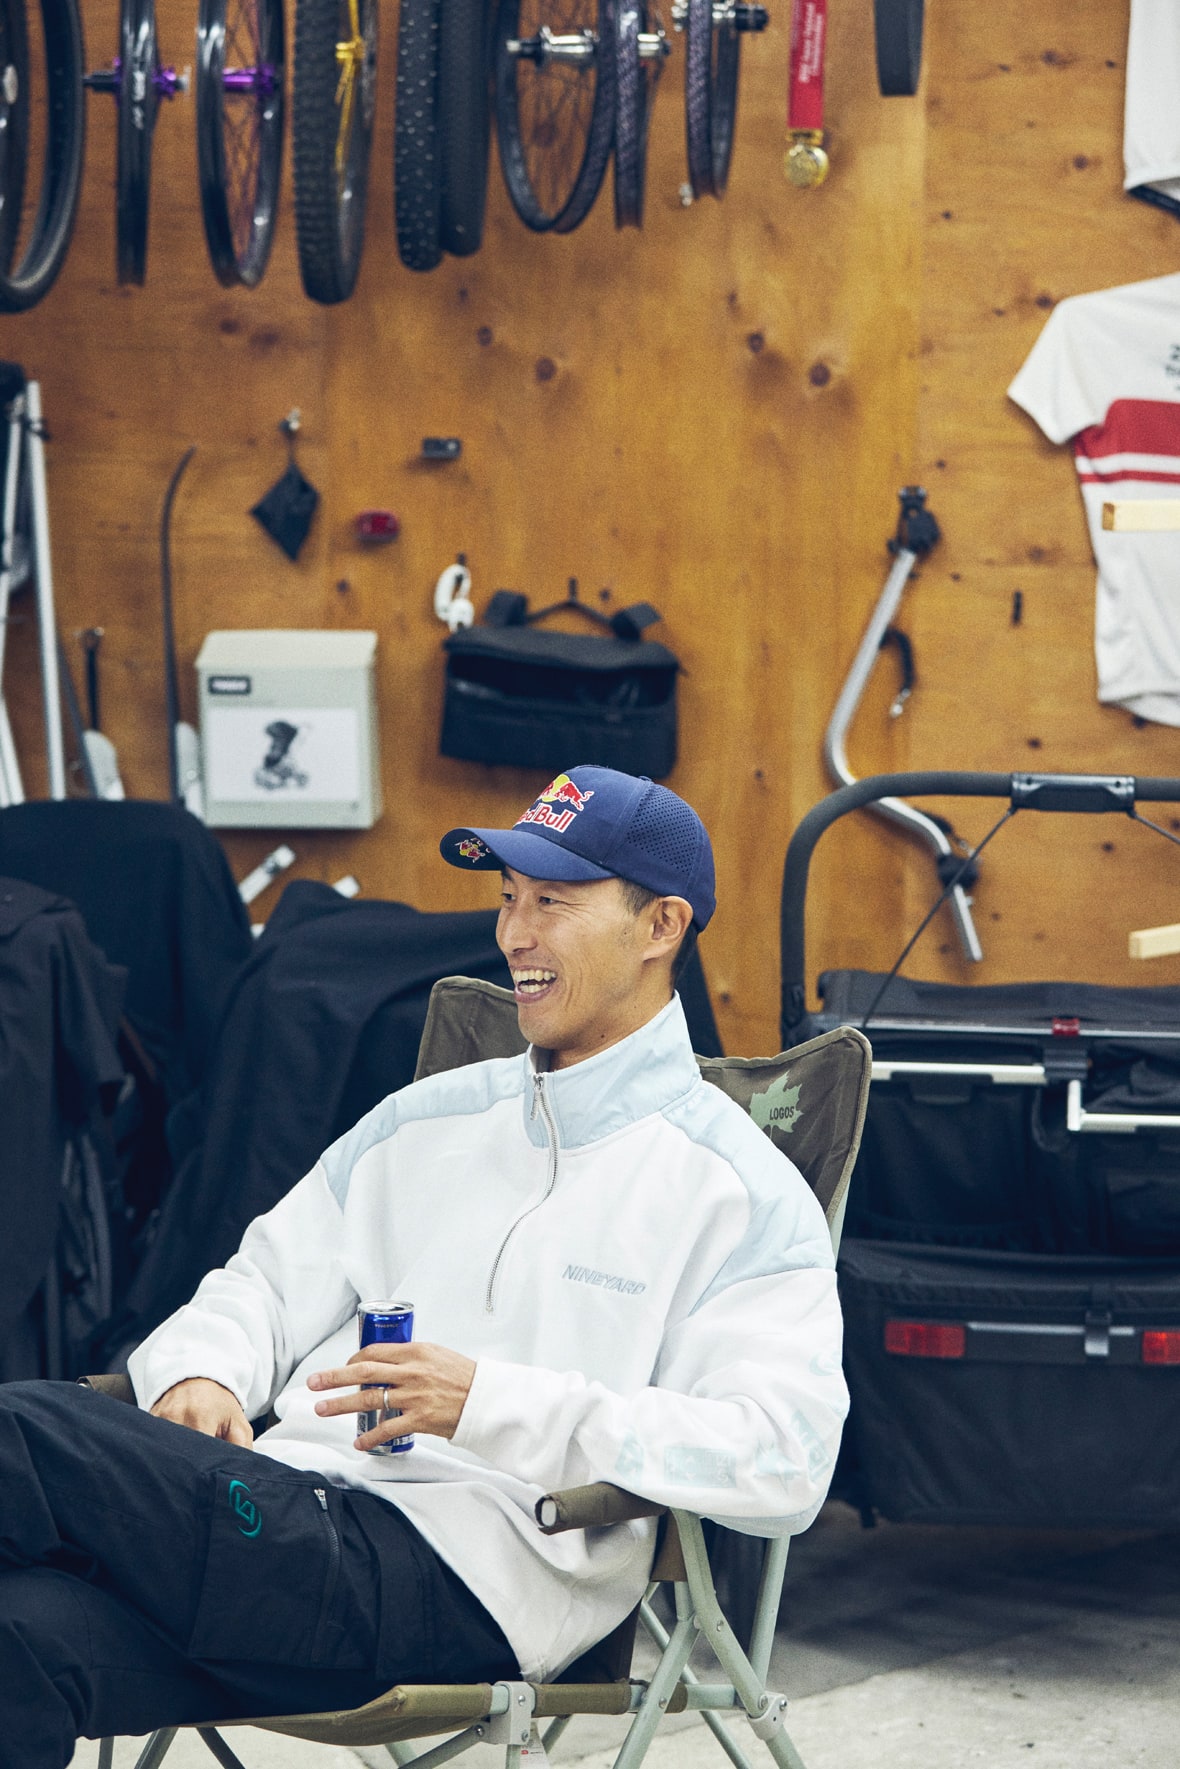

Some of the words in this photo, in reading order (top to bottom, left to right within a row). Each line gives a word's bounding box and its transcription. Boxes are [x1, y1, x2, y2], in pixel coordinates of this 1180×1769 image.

[533, 805, 575, 832] Bull
[769, 1106, 795, 1121] LOGOS
[561, 1264, 647, 1295] NINEYARD
